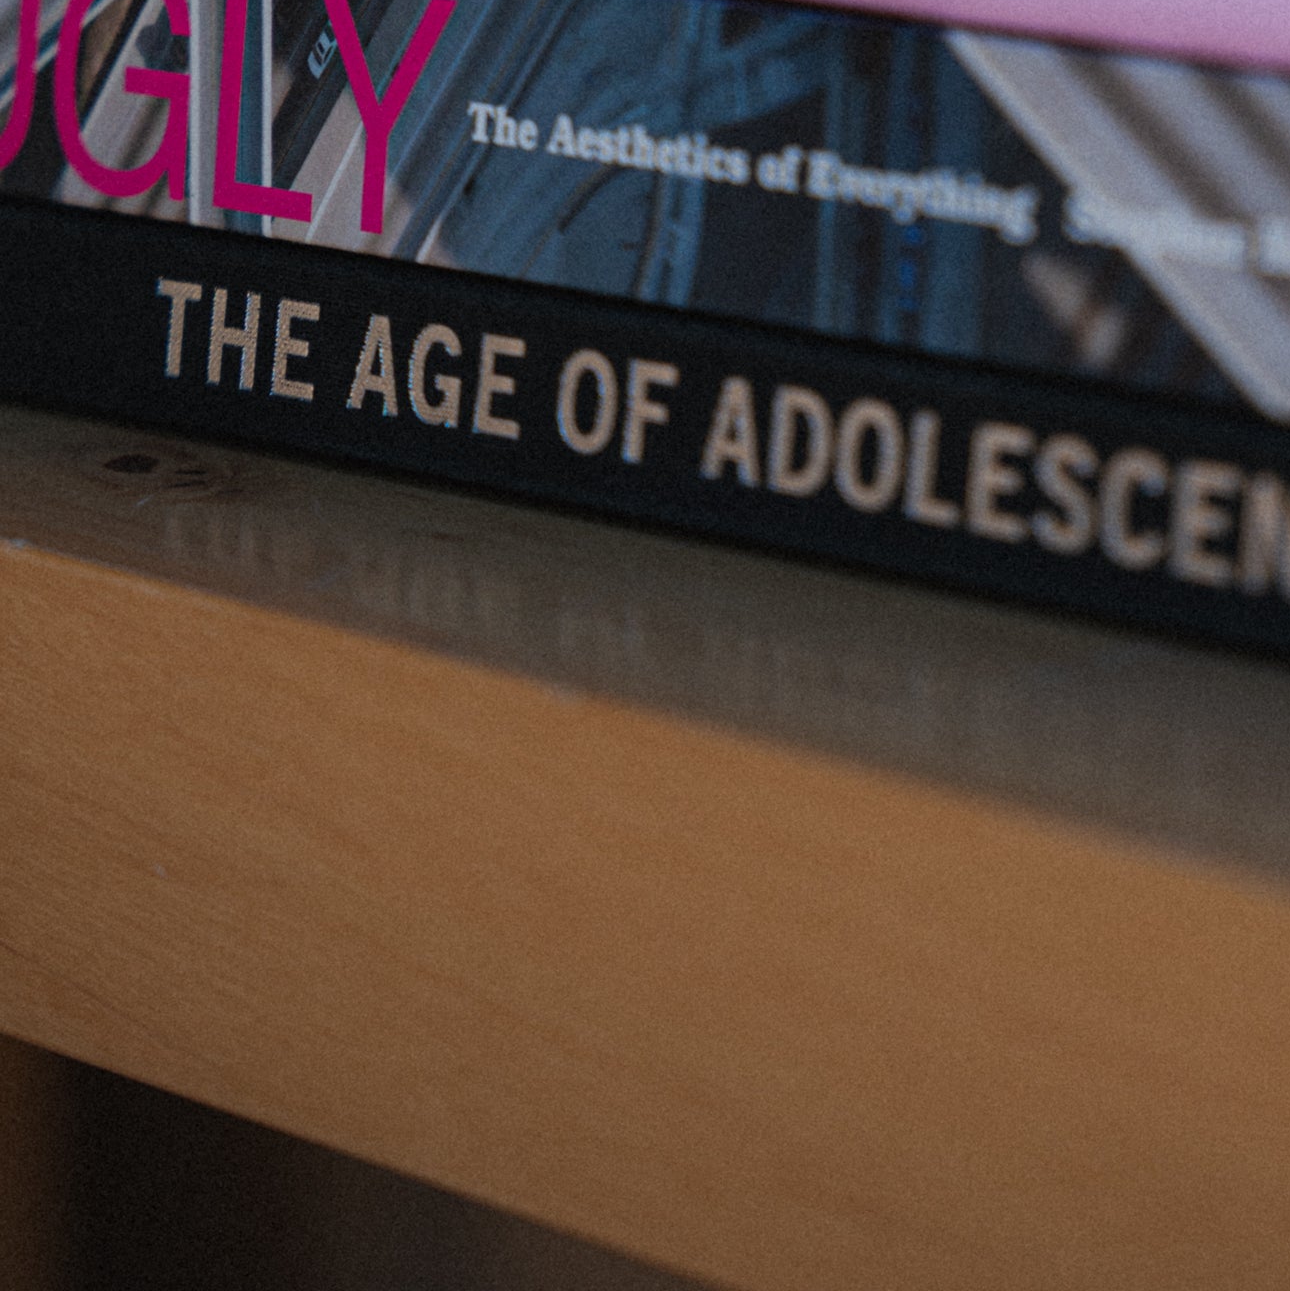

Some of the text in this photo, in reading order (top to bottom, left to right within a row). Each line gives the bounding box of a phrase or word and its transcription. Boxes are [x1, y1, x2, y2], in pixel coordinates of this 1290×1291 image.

[467, 100, 539, 152] The
[547, 112, 751, 186] Aesthetics
[756, 145, 804, 194] of
[804, 150, 1040, 247] Everything
[157, 276, 321, 402] THE
[346, 313, 526, 440] AGE
[555, 347, 680, 464] OF
